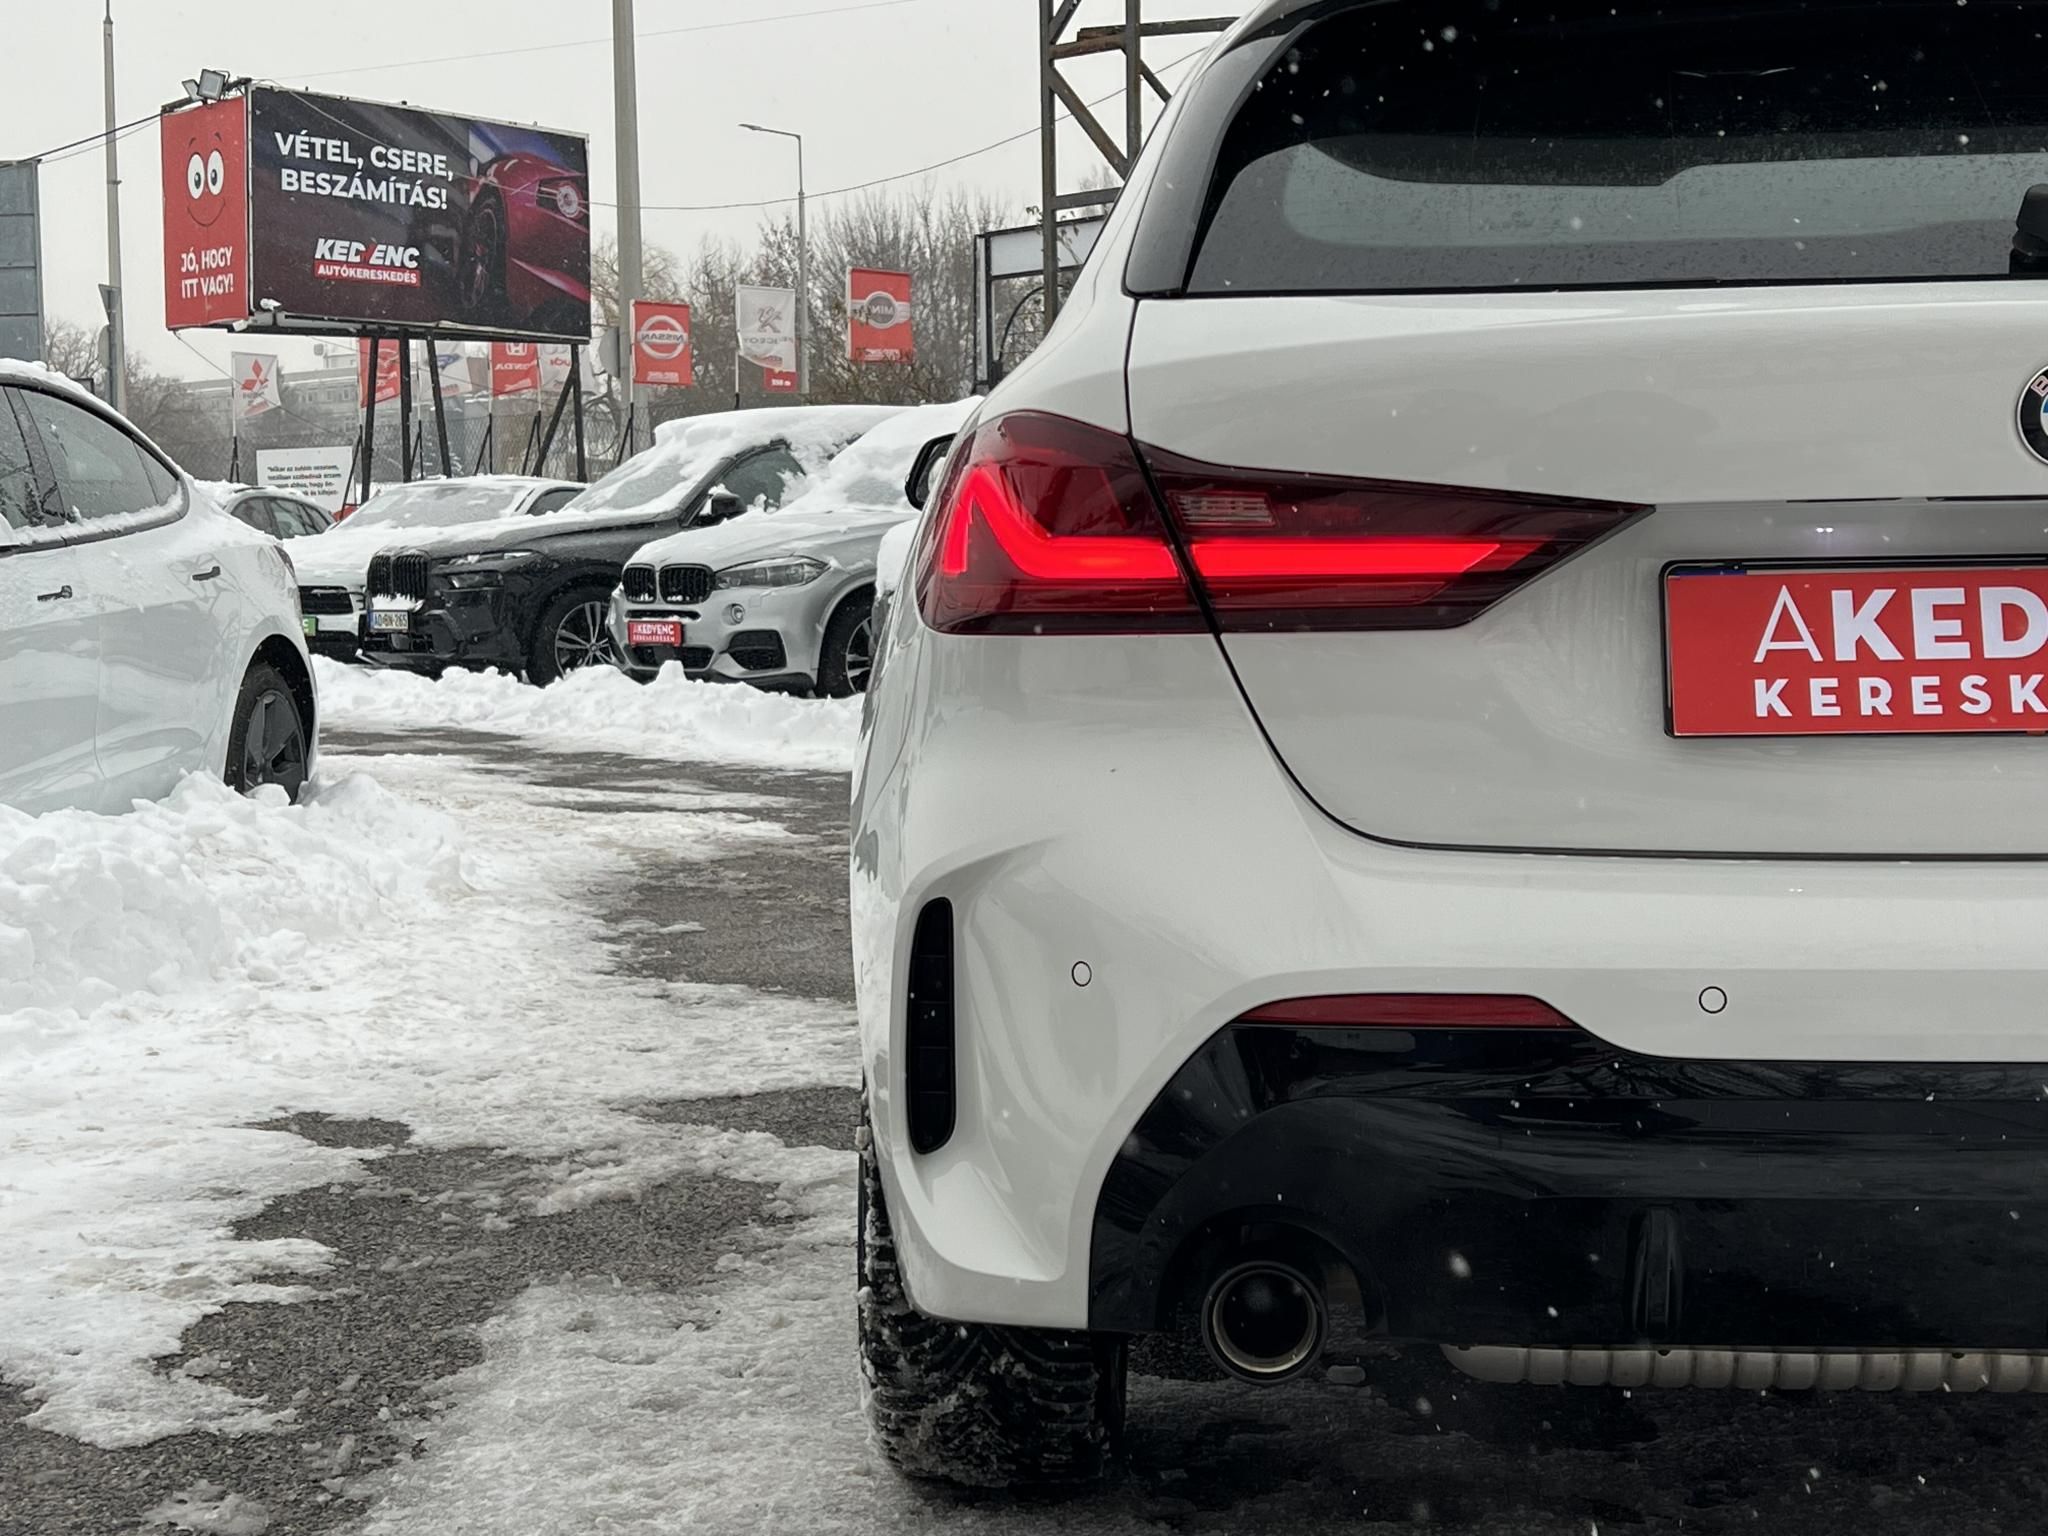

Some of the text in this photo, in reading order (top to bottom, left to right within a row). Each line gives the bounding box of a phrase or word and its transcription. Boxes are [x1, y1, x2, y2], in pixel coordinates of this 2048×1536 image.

[274, 129, 454, 182] VÉTEL, CSERE,
[281, 168, 448, 210] BESZÁMÍTÁS!
[180, 245, 233, 275] JÓ, HOGY
[317, 264, 417, 284] AUTÓKERESKEDÉS
[181, 272, 234, 299] ITT VAGY!
[1753, 674, 2048, 718] KERESK
